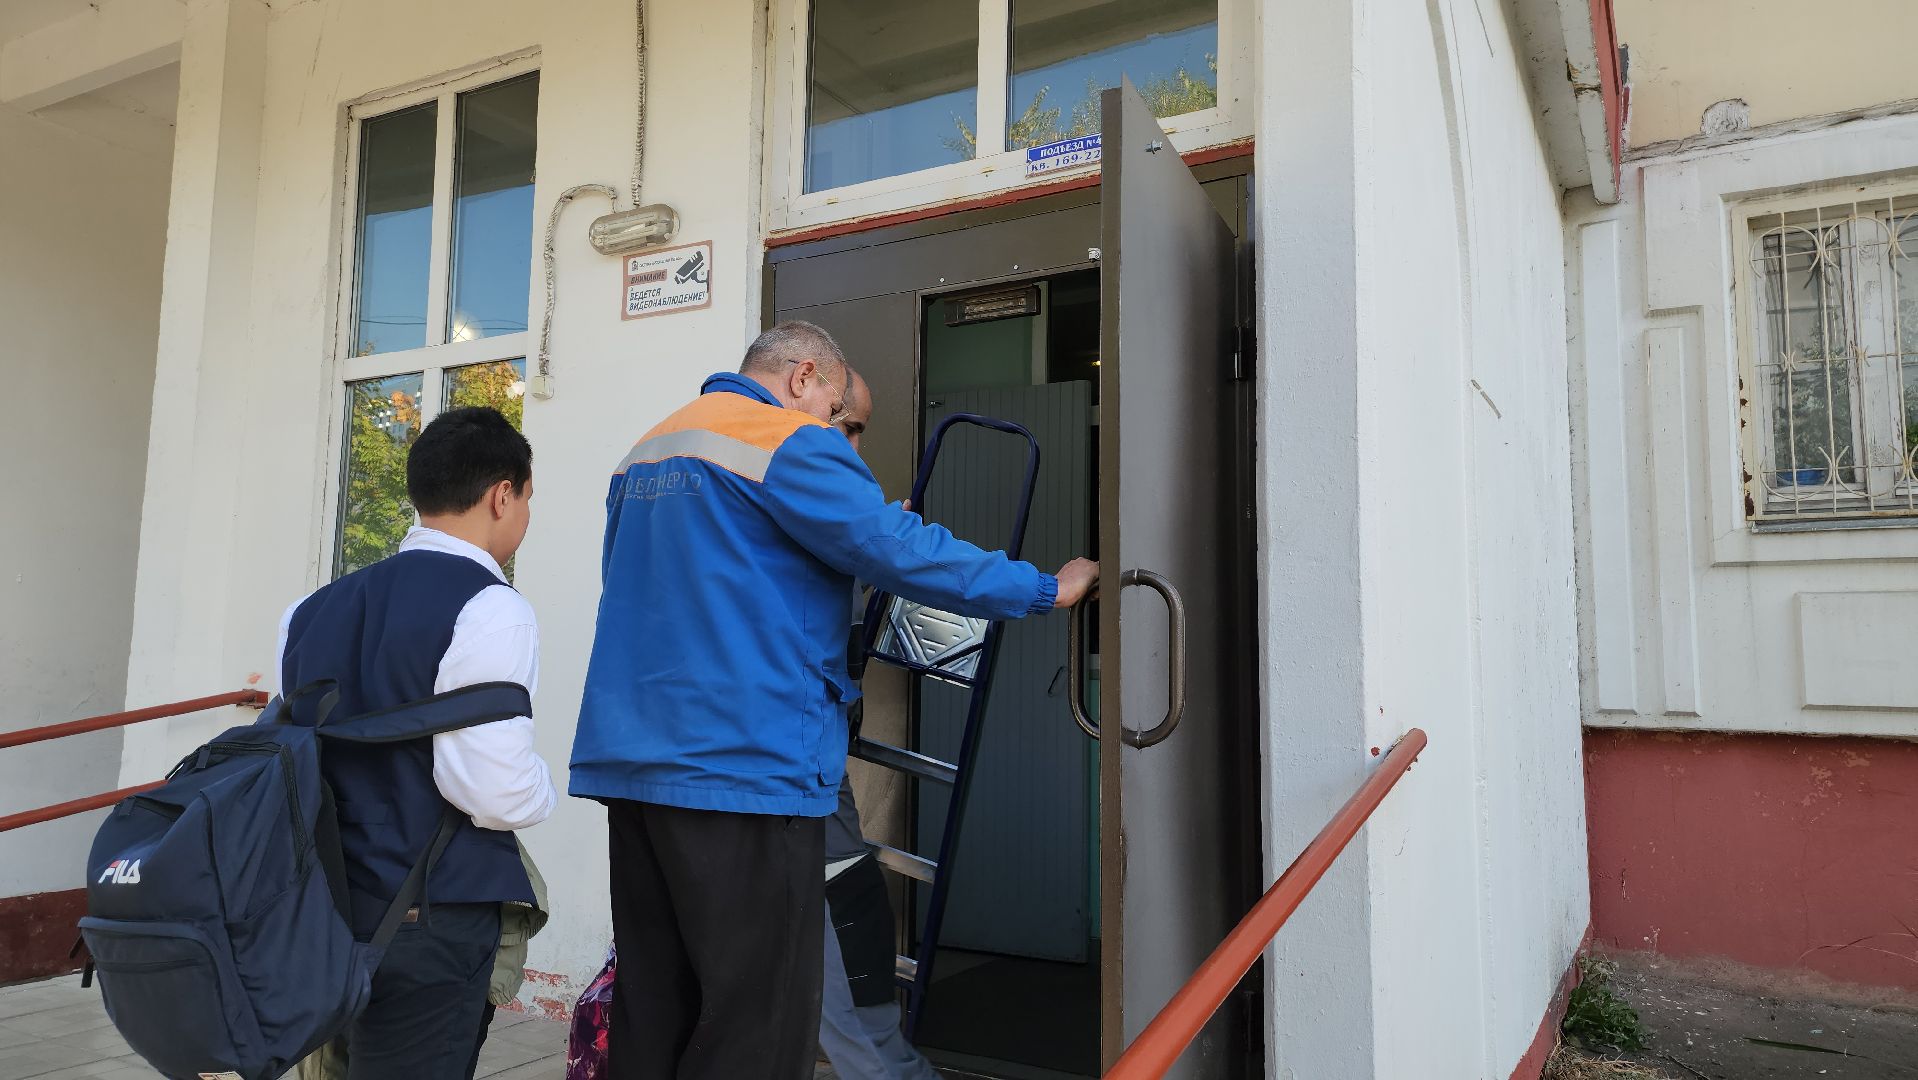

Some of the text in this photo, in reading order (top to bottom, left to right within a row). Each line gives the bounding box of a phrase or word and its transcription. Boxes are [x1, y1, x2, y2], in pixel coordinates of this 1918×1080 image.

[1041, 141, 1084, 157] ПОДЪЕЗД
[1056, 149, 1101, 166] 169-22
[630, 271, 665, 284] ВНИМАНИЕ
[629, 291, 706, 311] ВИДЕОНАБЛЮДЕНИЕ!
[630, 288, 661, 301] ВЕДЕТСЯ
[98, 859, 141, 884] FILA
